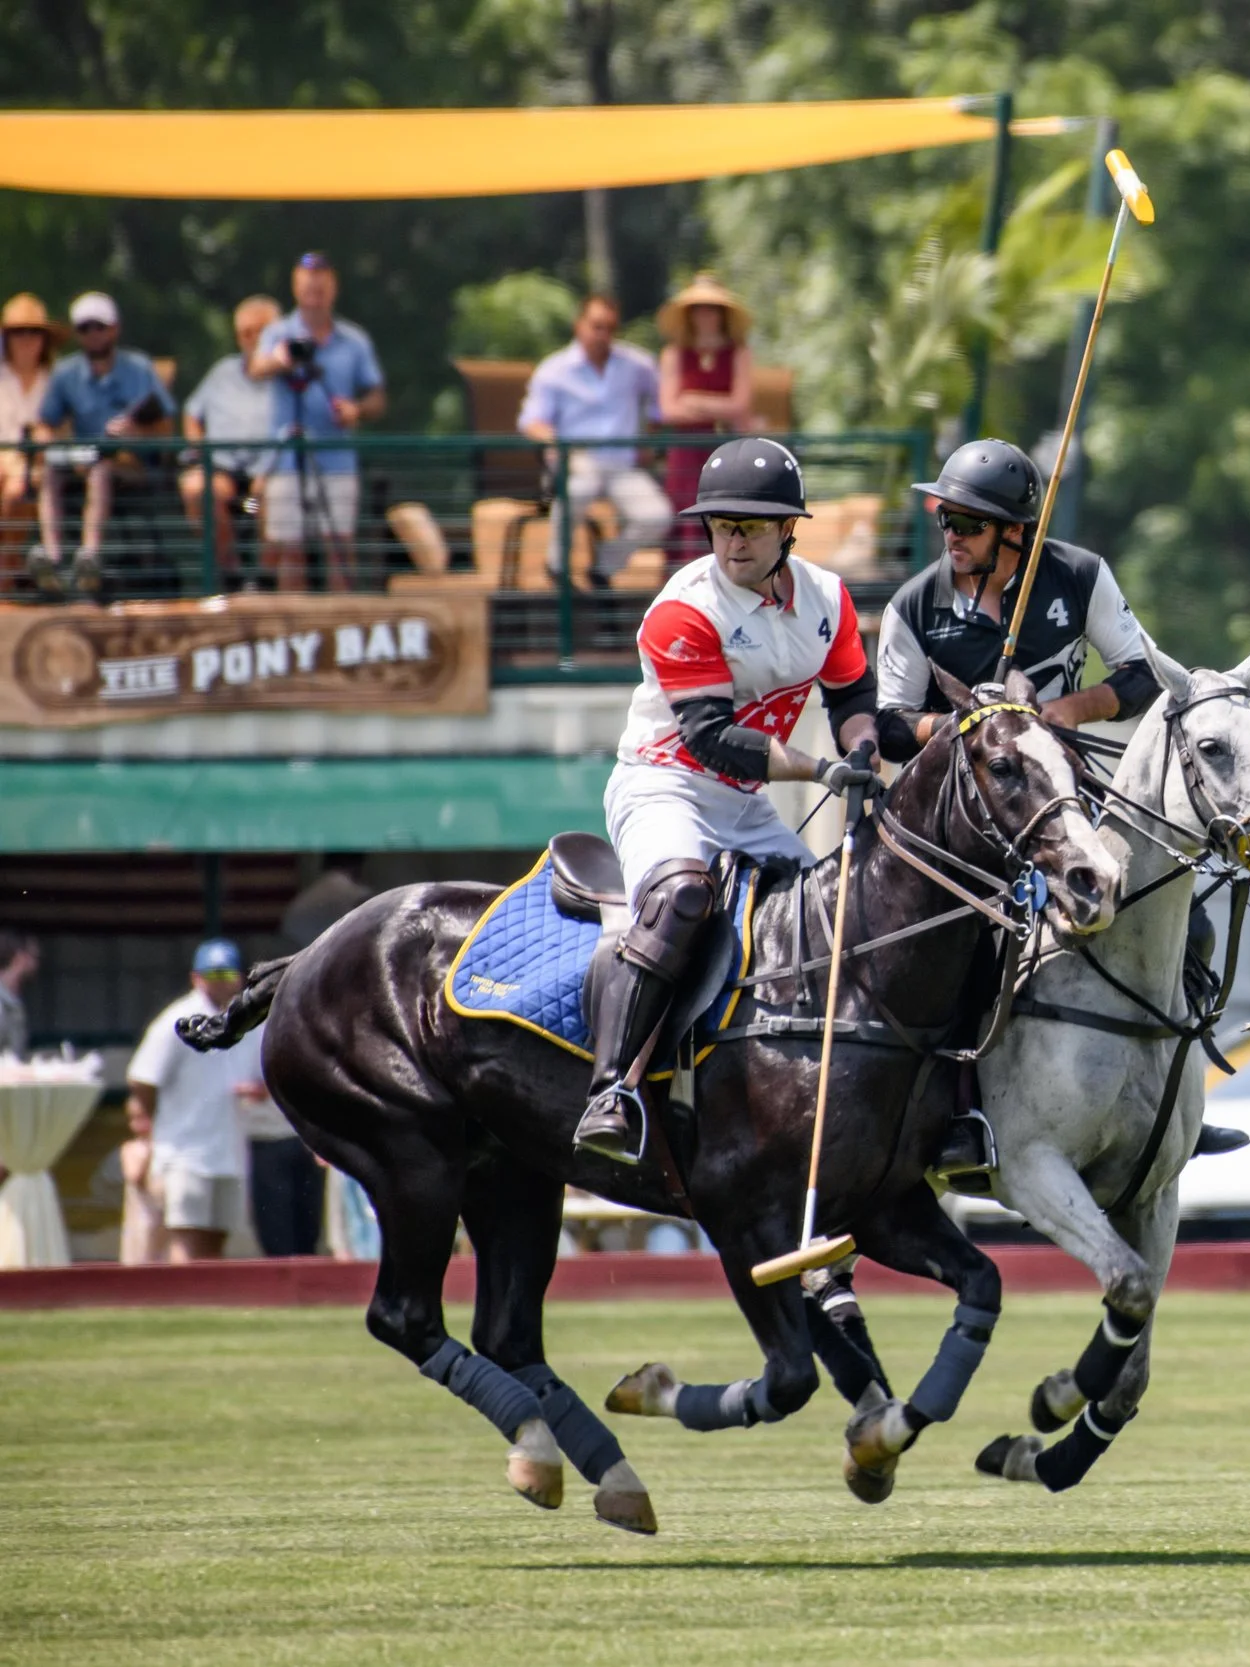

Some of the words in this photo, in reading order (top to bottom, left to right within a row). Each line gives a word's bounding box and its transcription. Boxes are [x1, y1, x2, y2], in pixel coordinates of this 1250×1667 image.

[1046, 597, 1069, 627] 4
[817, 617, 832, 643] 4
[98, 657, 179, 698] THE
[191, 629, 322, 692] PONY
[334, 619, 430, 666] BAR
